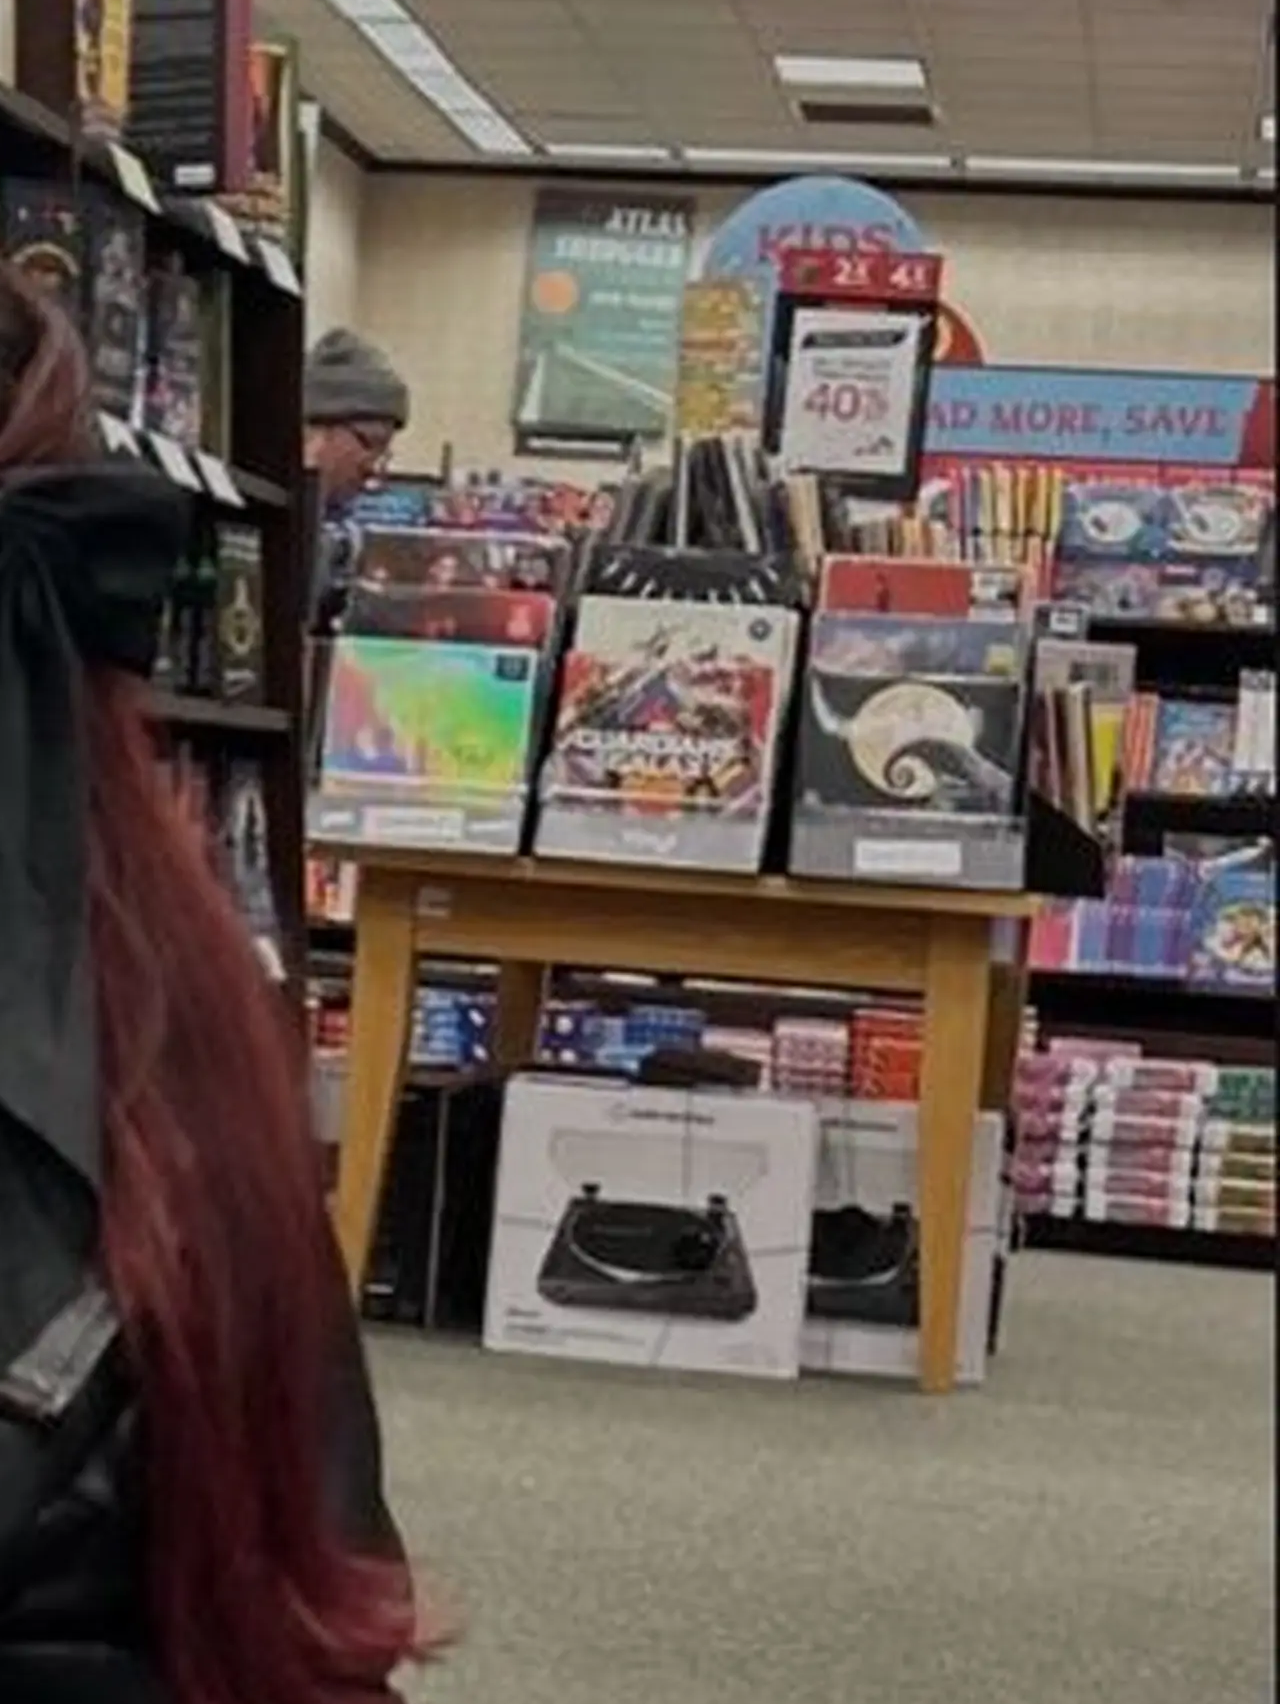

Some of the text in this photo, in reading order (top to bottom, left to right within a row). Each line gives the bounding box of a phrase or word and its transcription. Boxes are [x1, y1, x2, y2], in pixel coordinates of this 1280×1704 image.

[605, 207, 686, 236] ATLAS
[991, 401, 1111, 443] MORE,
[1122, 403, 1228, 438] SAVE
